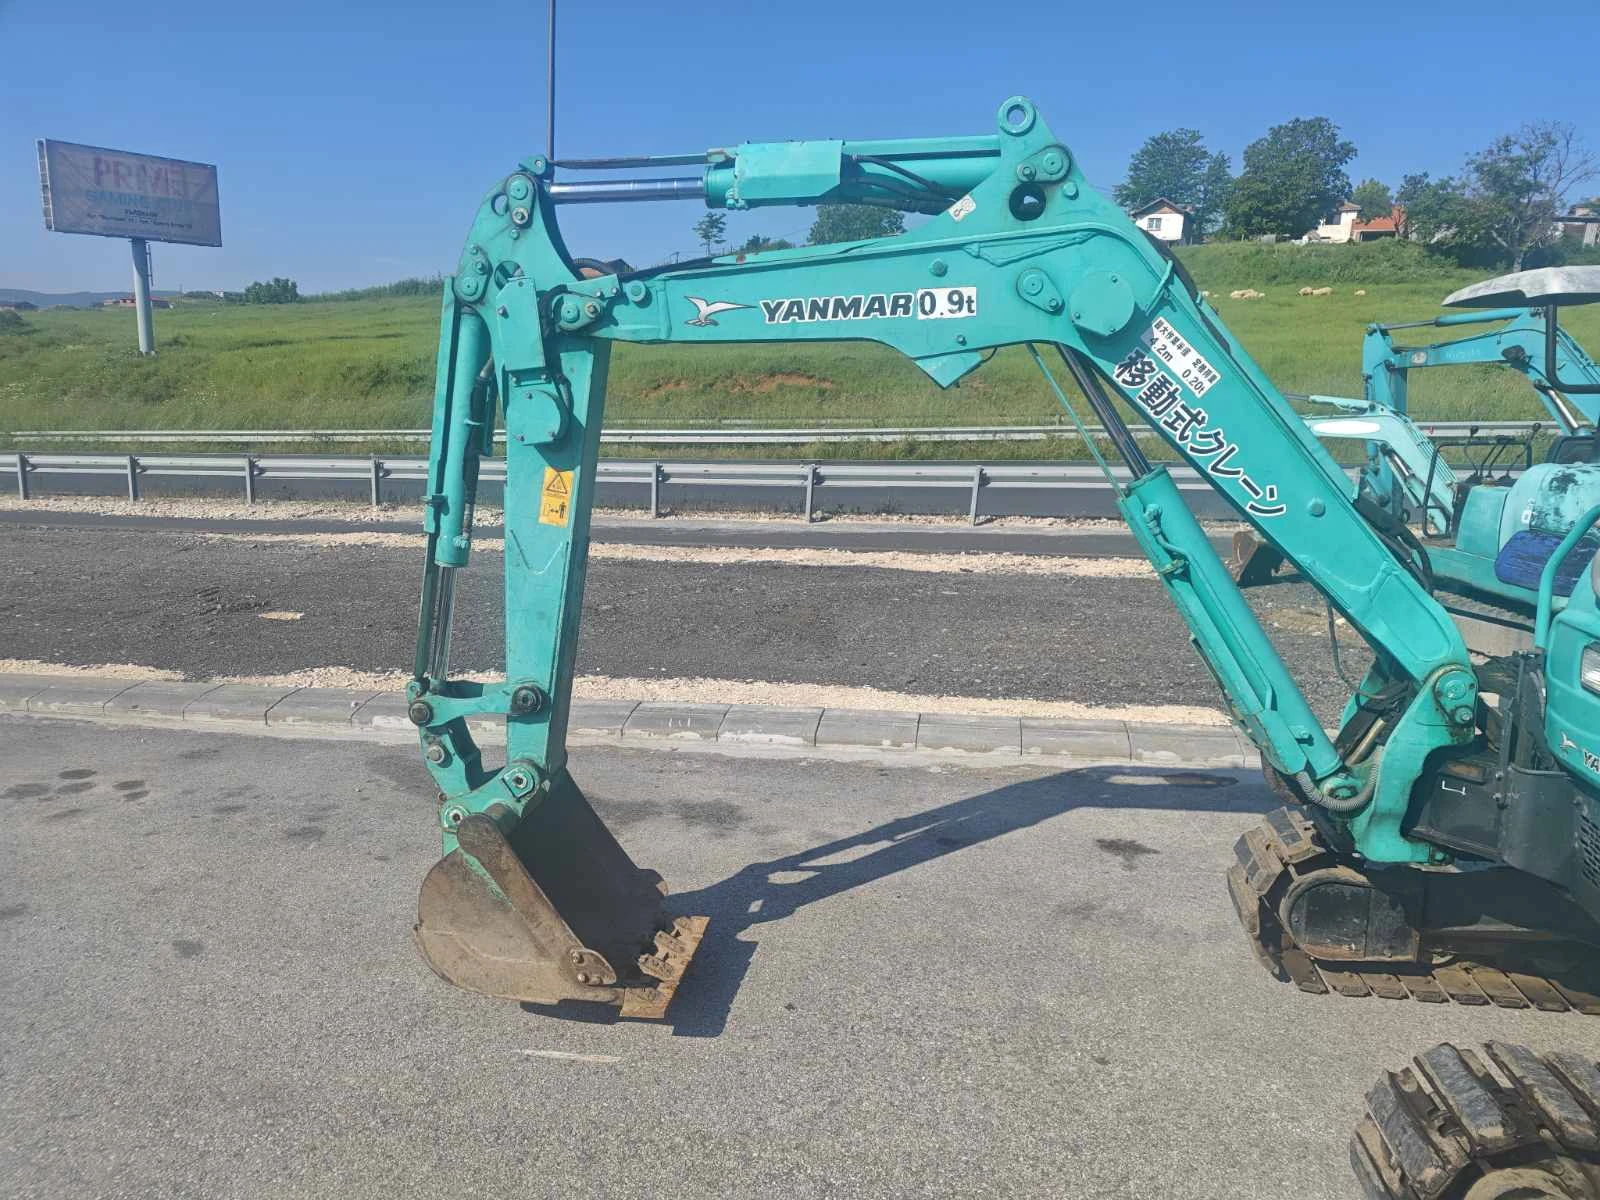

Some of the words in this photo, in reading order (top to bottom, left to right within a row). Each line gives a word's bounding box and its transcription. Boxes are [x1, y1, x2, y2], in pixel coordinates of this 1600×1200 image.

[761, 293, 914, 323] YANMAR
[919, 289, 976, 316] 0.9t
[1150, 337, 1173, 362] 4.2m
[1182, 368, 1206, 395] 0.20t
[1115, 349, 1286, 514] 移動式クレーン
